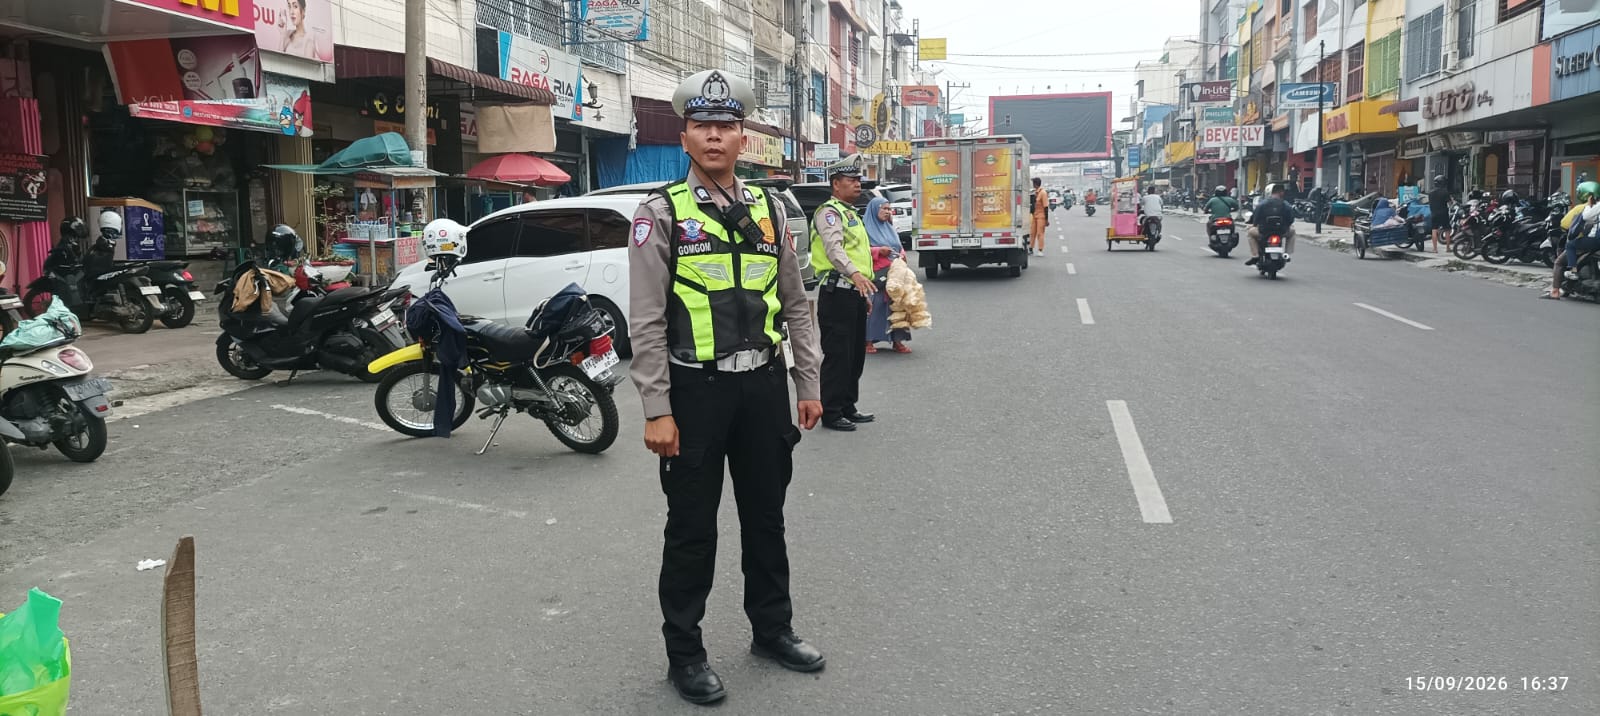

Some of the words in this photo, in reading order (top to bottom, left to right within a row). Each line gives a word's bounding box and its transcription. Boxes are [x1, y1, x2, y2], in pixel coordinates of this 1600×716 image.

[1555, 50, 1591, 76] SLEEP
[511, 67, 550, 92] RAGA
[554, 78, 574, 97] RIA
[1206, 127, 1262, 142] BEVERLY
[678, 242, 712, 256] GOMGOM
